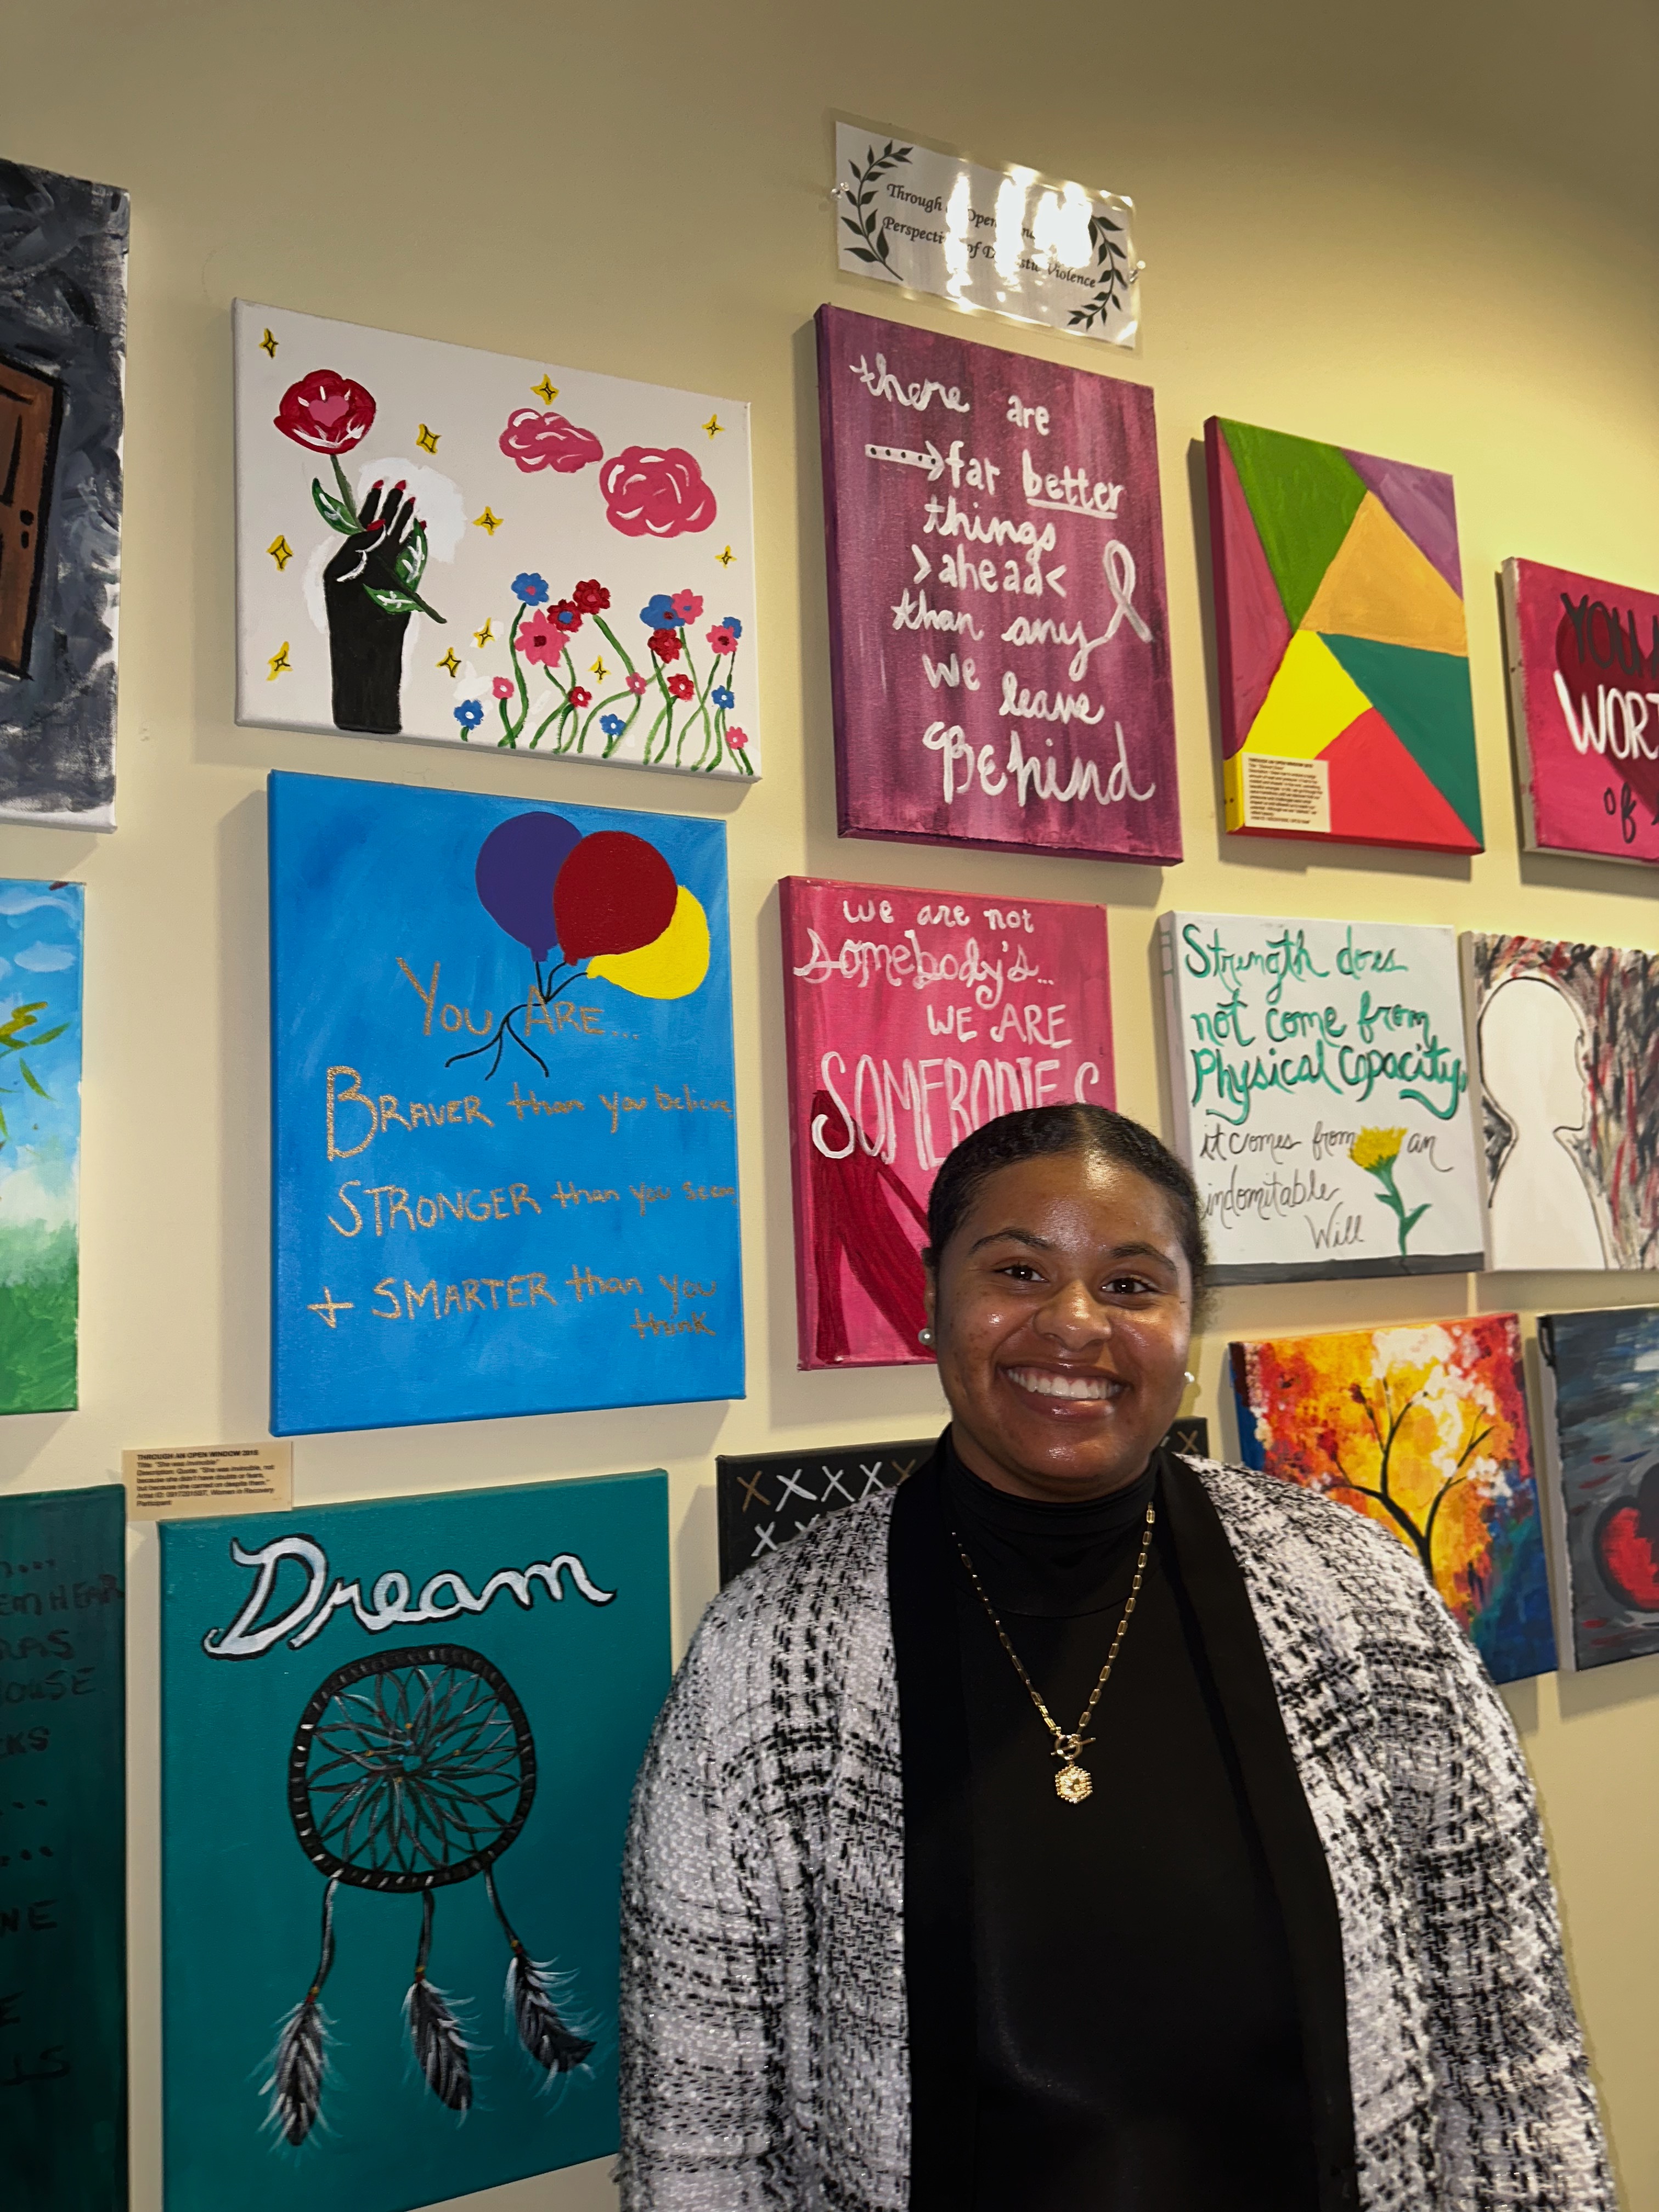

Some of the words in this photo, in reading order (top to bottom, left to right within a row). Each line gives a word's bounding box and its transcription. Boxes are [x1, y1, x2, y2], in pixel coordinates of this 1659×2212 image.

[887, 183, 943, 212] Through
[882, 216, 945, 245] Perspecti
[849, 352, 969, 411] there
[1007, 395, 1050, 436] are
[945, 441, 1001, 495] far
[1022, 449, 1125, 511] better
[923, 496, 1056, 565] things
[890, 588, 984, 641] than
[1001, 616, 1092, 682] any
[1560, 592, 1643, 679] YOU
[998, 671, 1105, 725] leave
[1604, 782, 1637, 844] of
[916, 904, 971, 928] are
[983, 908, 1035, 934] not
[1182, 923, 1330, 1005] Strength
[1336, 925, 1409, 980] does
[927, 1005, 978, 1043] WE
[990, 1003, 1073, 1049] ARE
[1190, 989, 1256, 1047] not
[1357, 990, 1432, 1047] from
[326, 1065, 495, 1161] BRAVER
[508, 1082, 585, 1120] than
[1190, 1039, 1344, 1126] Physical
[1200, 1122, 1228, 1161] it
[1312, 1120, 1356, 1160] from
[1407, 1133, 1454, 1173] an
[328, 1180, 542, 1237] STRONGER
[551, 1181, 619, 1209] than
[1200, 1165, 1340, 1230] indomitable
[1305, 1201, 1364, 1249] Will
[371, 1271, 557, 1320] SMARTER
[565, 1265, 644, 1301] than
[201, 1532, 618, 1662] Dream
